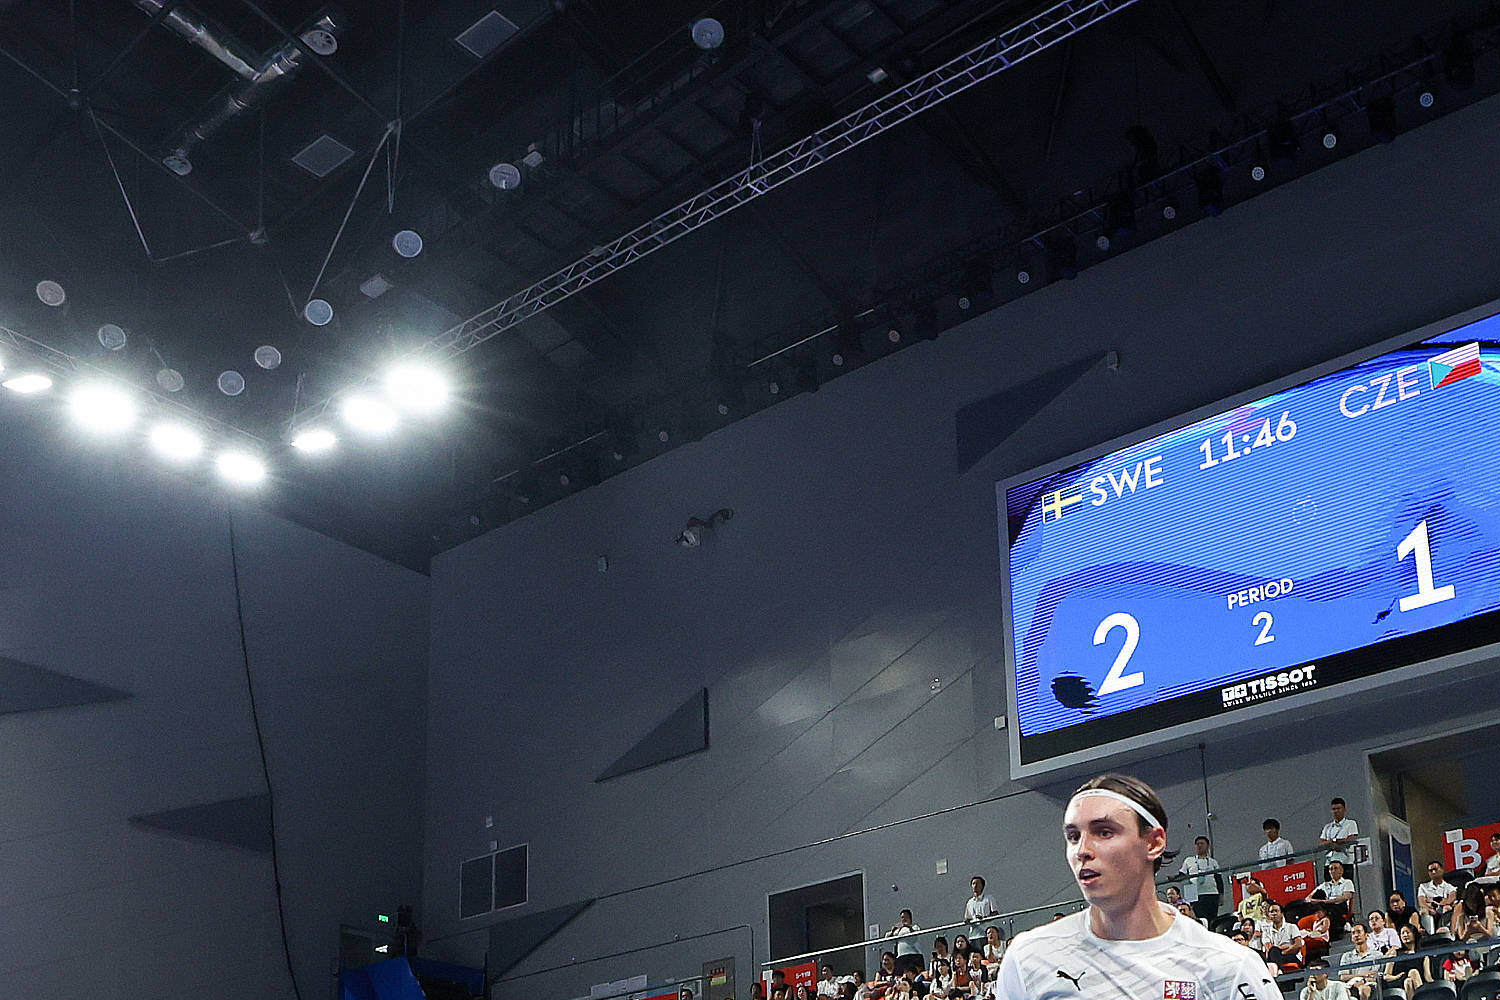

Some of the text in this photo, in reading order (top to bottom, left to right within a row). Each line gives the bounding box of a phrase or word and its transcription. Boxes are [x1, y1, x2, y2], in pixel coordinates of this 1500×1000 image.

[1339, 365, 1422, 419] CZE
[1199, 411, 1299, 470] 11:46
[1090, 455, 1165, 507] SWE
[1396, 520, 1456, 613] 1
[1227, 577, 1295, 610] PERIOD
[1092, 612, 1145, 697] 2
[1252, 611, 1275, 646] 2
[1247, 664, 1316, 695] TISSOT
[1453, 838, 1484, 870] B
